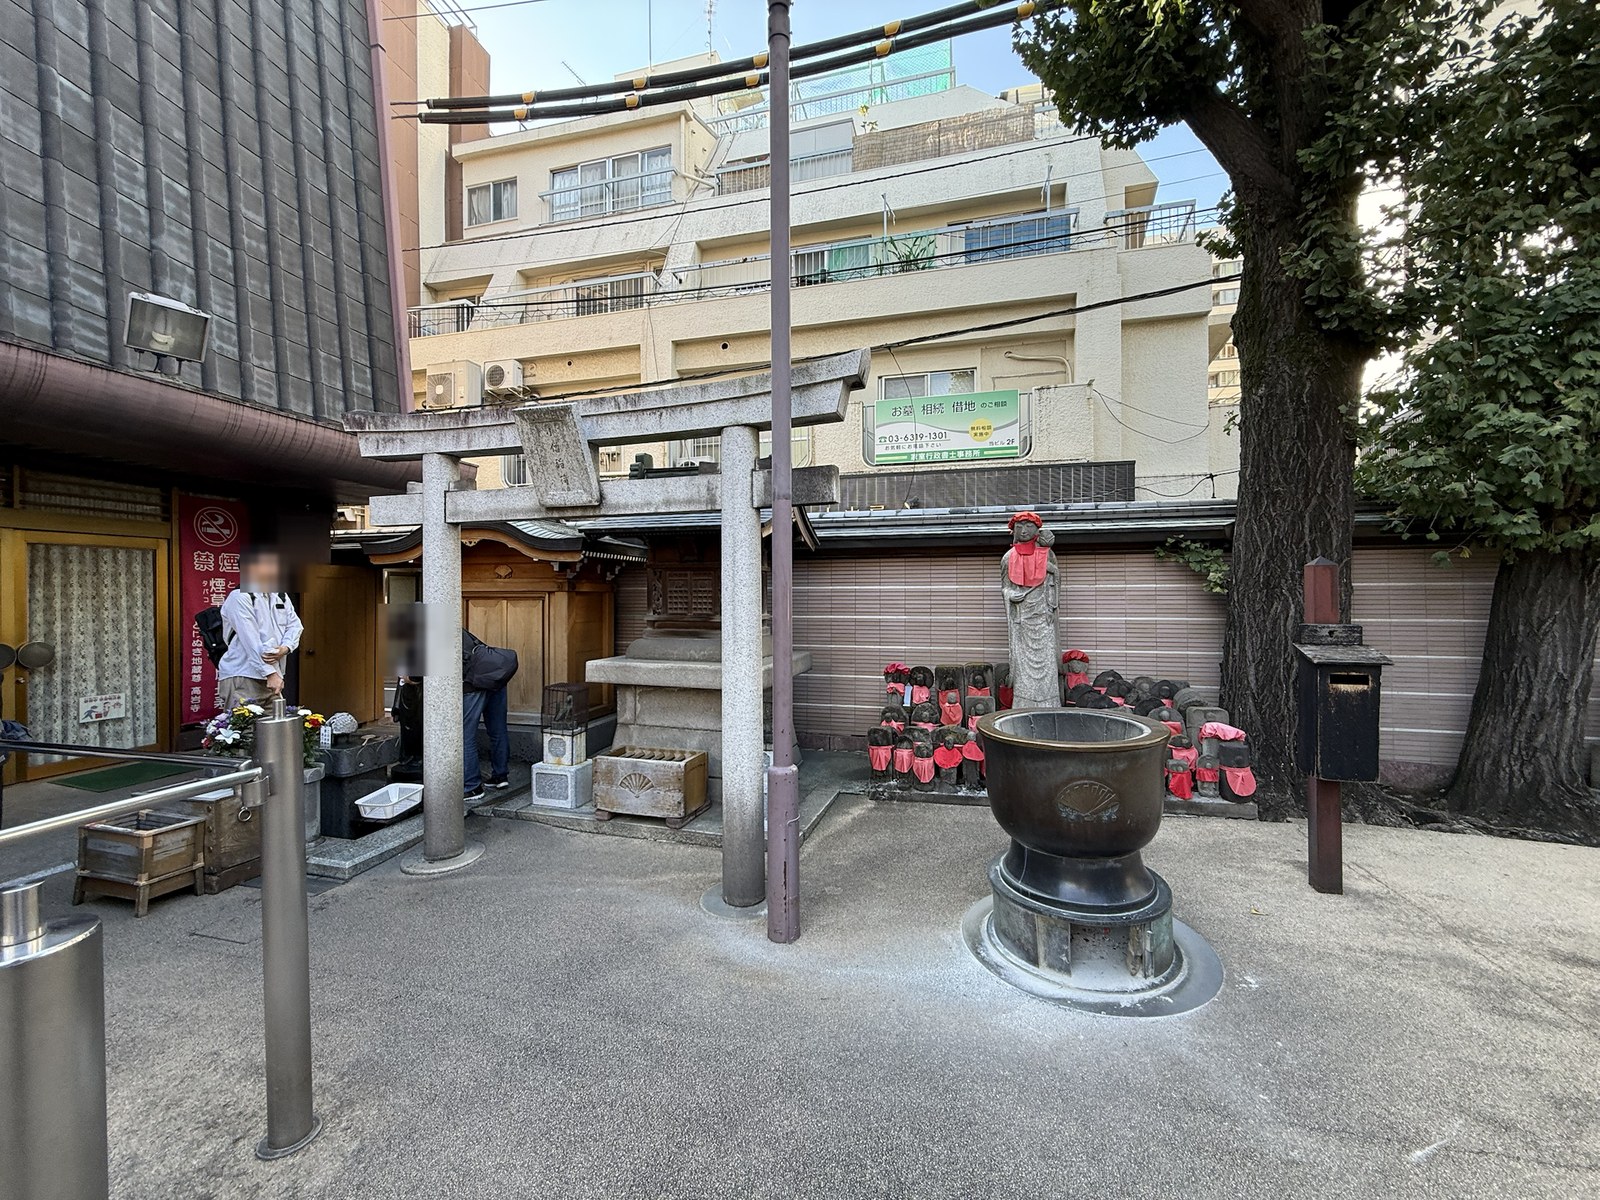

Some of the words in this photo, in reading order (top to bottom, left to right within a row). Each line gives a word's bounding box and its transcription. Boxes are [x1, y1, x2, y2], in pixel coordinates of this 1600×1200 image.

[921, 402, 945, 415] 相続
[952, 400, 976, 413] 借地
[980, 400, 1008, 409] のご相談
[888, 432, 948, 443] 03-6319-1301
[1006, 438, 1015, 446] 2F
[193, 550, 240, 573] 禁煙
